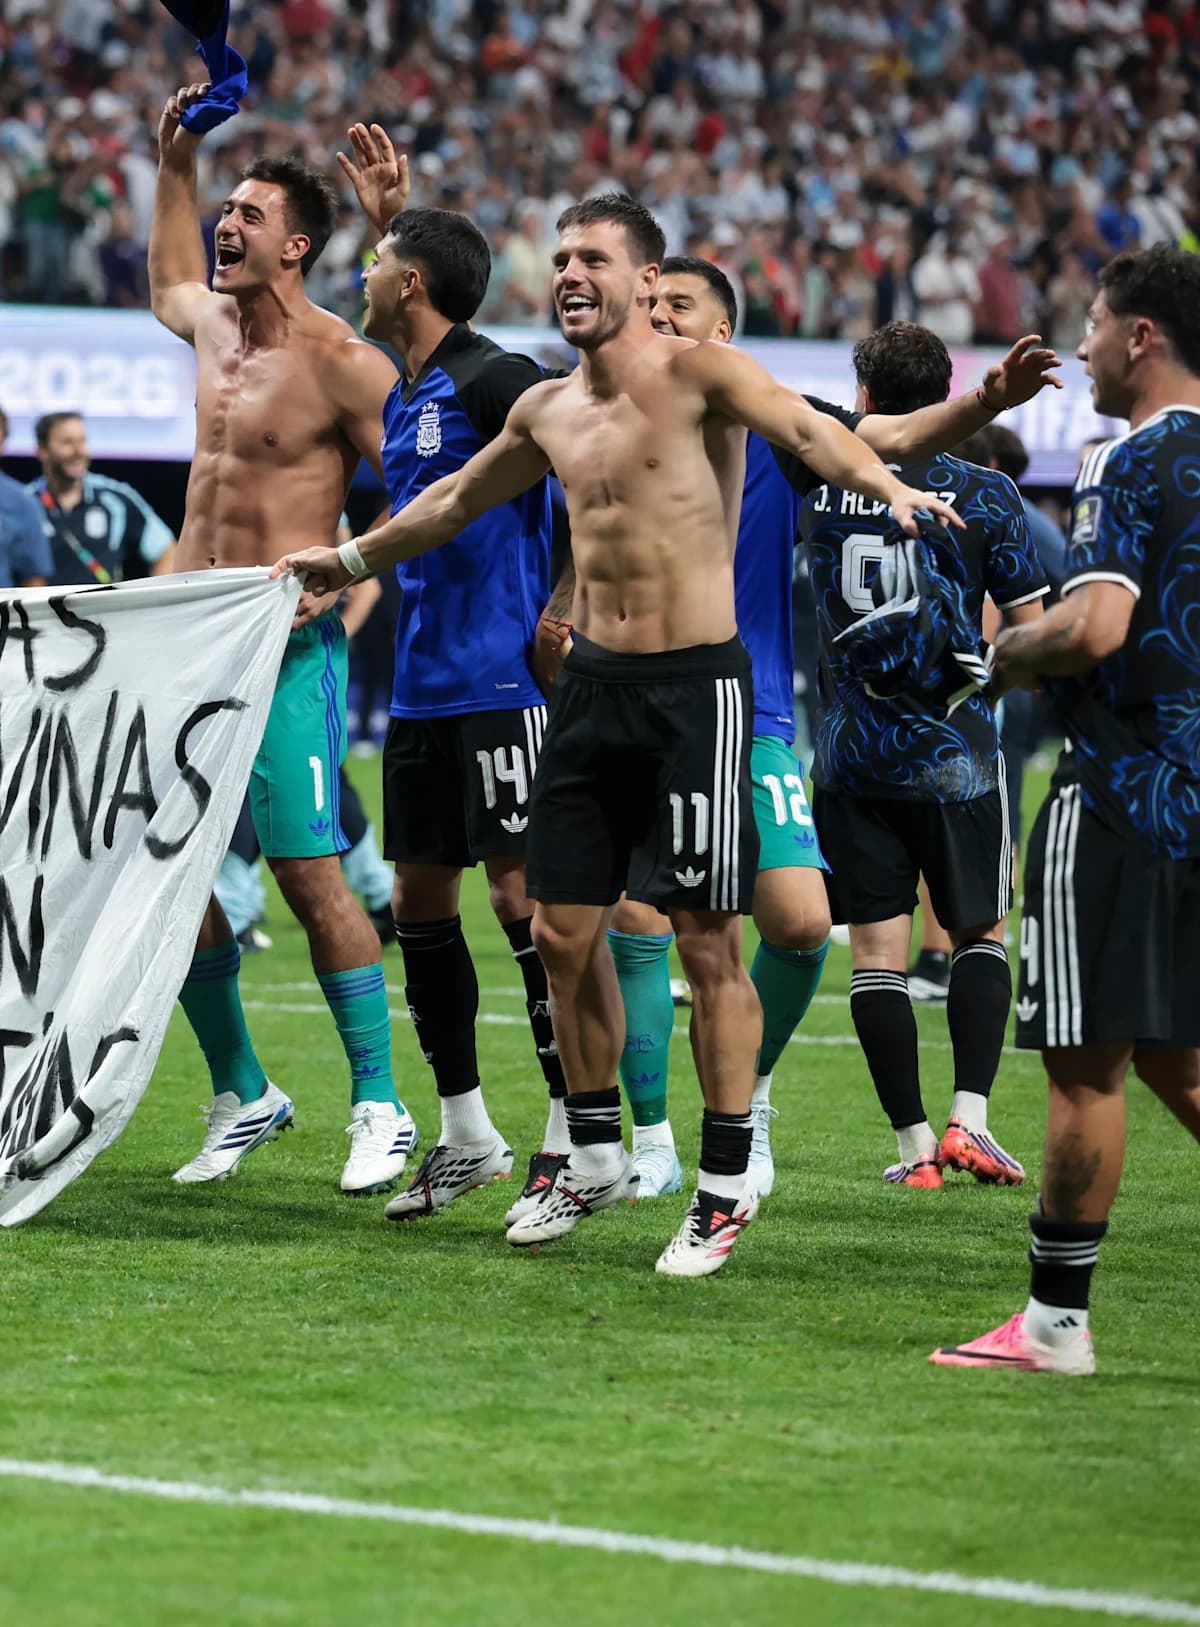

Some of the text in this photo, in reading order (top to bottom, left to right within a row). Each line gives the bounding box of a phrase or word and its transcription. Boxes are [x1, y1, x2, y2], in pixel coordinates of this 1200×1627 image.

[813, 483, 957, 518] J. ALVZ
[308, 755, 325, 812] 1
[476, 745, 529, 809] 14
[763, 773, 813, 827] 12
[669, 792, 709, 855] 11
